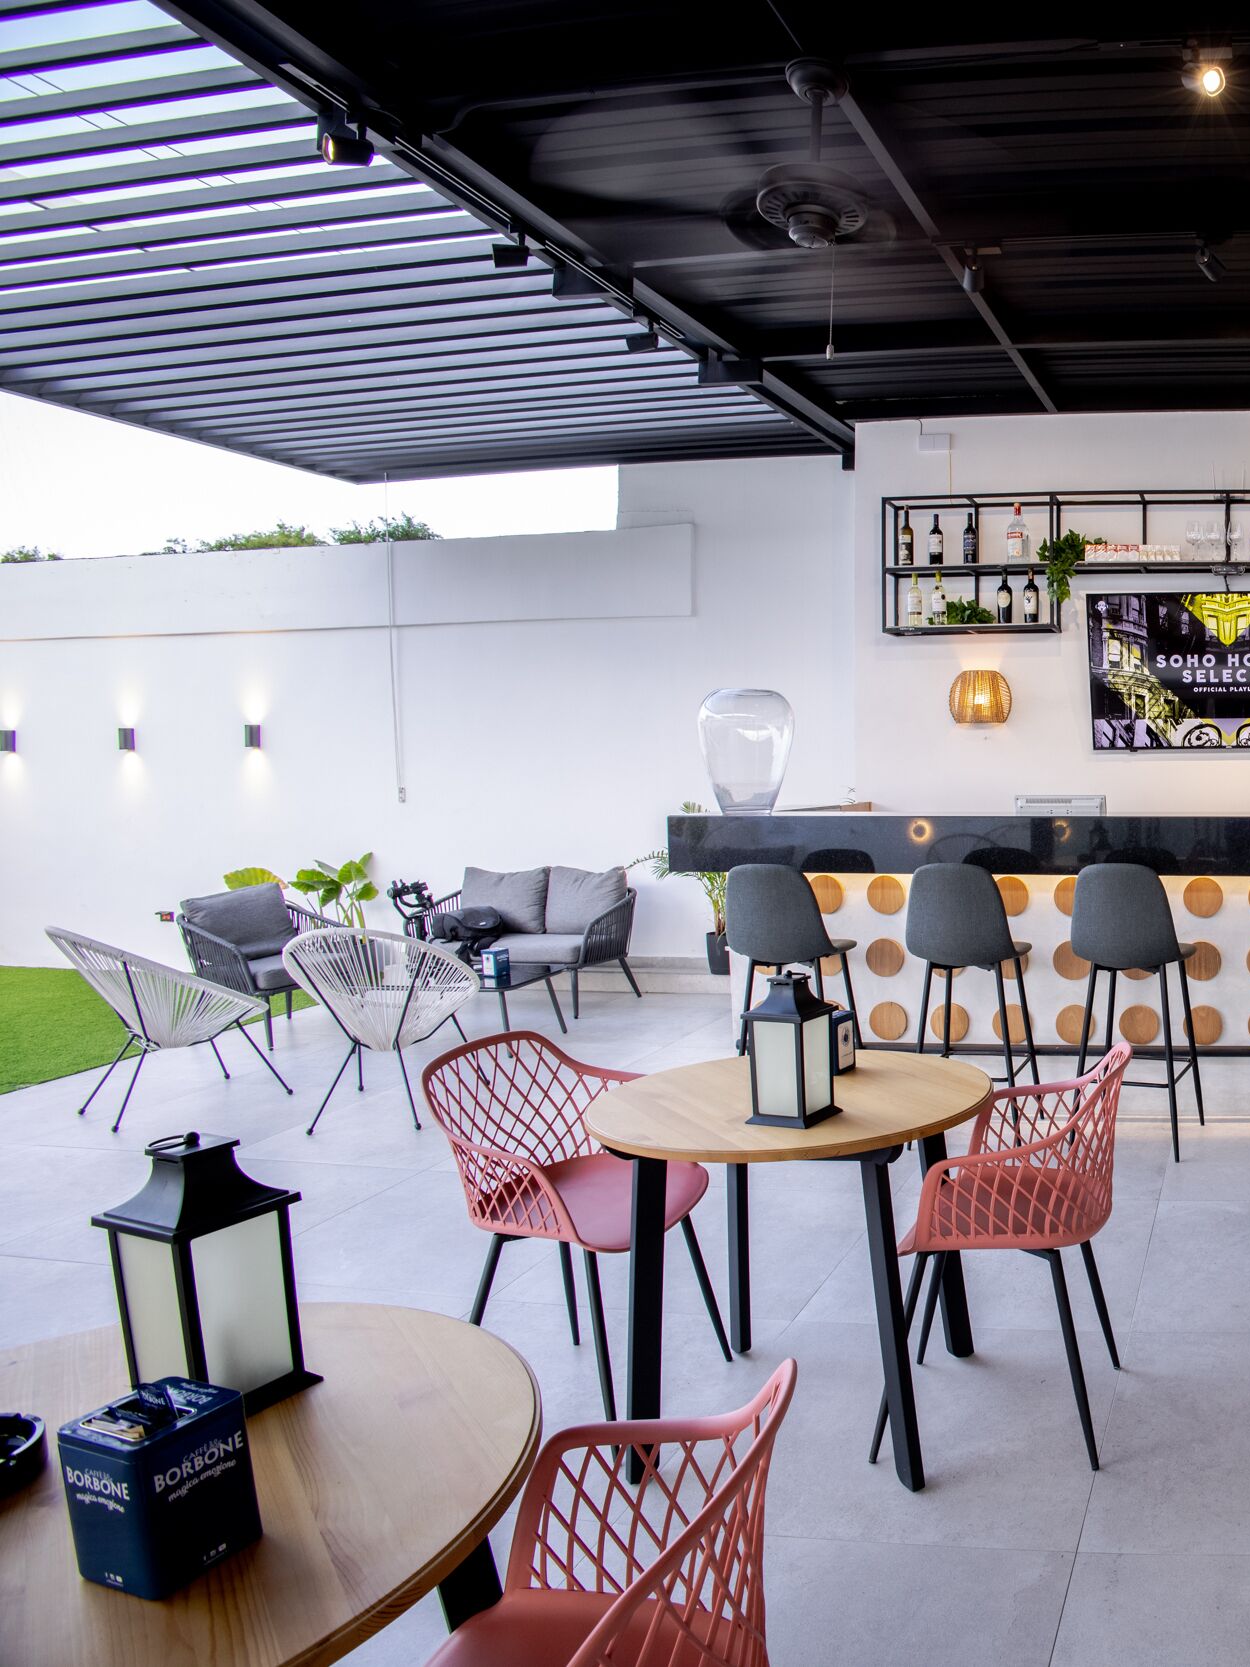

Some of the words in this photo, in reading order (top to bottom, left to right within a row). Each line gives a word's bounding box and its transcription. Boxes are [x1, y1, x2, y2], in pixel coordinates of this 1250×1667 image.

[1156, 654, 1216, 668] SOHO
[154, 1430, 244, 1493] BORBONE
[168, 1477, 200, 1502] magica
[200, 1459, 237, 1480] emozione
[66, 1466, 130, 1501] BORBONE
